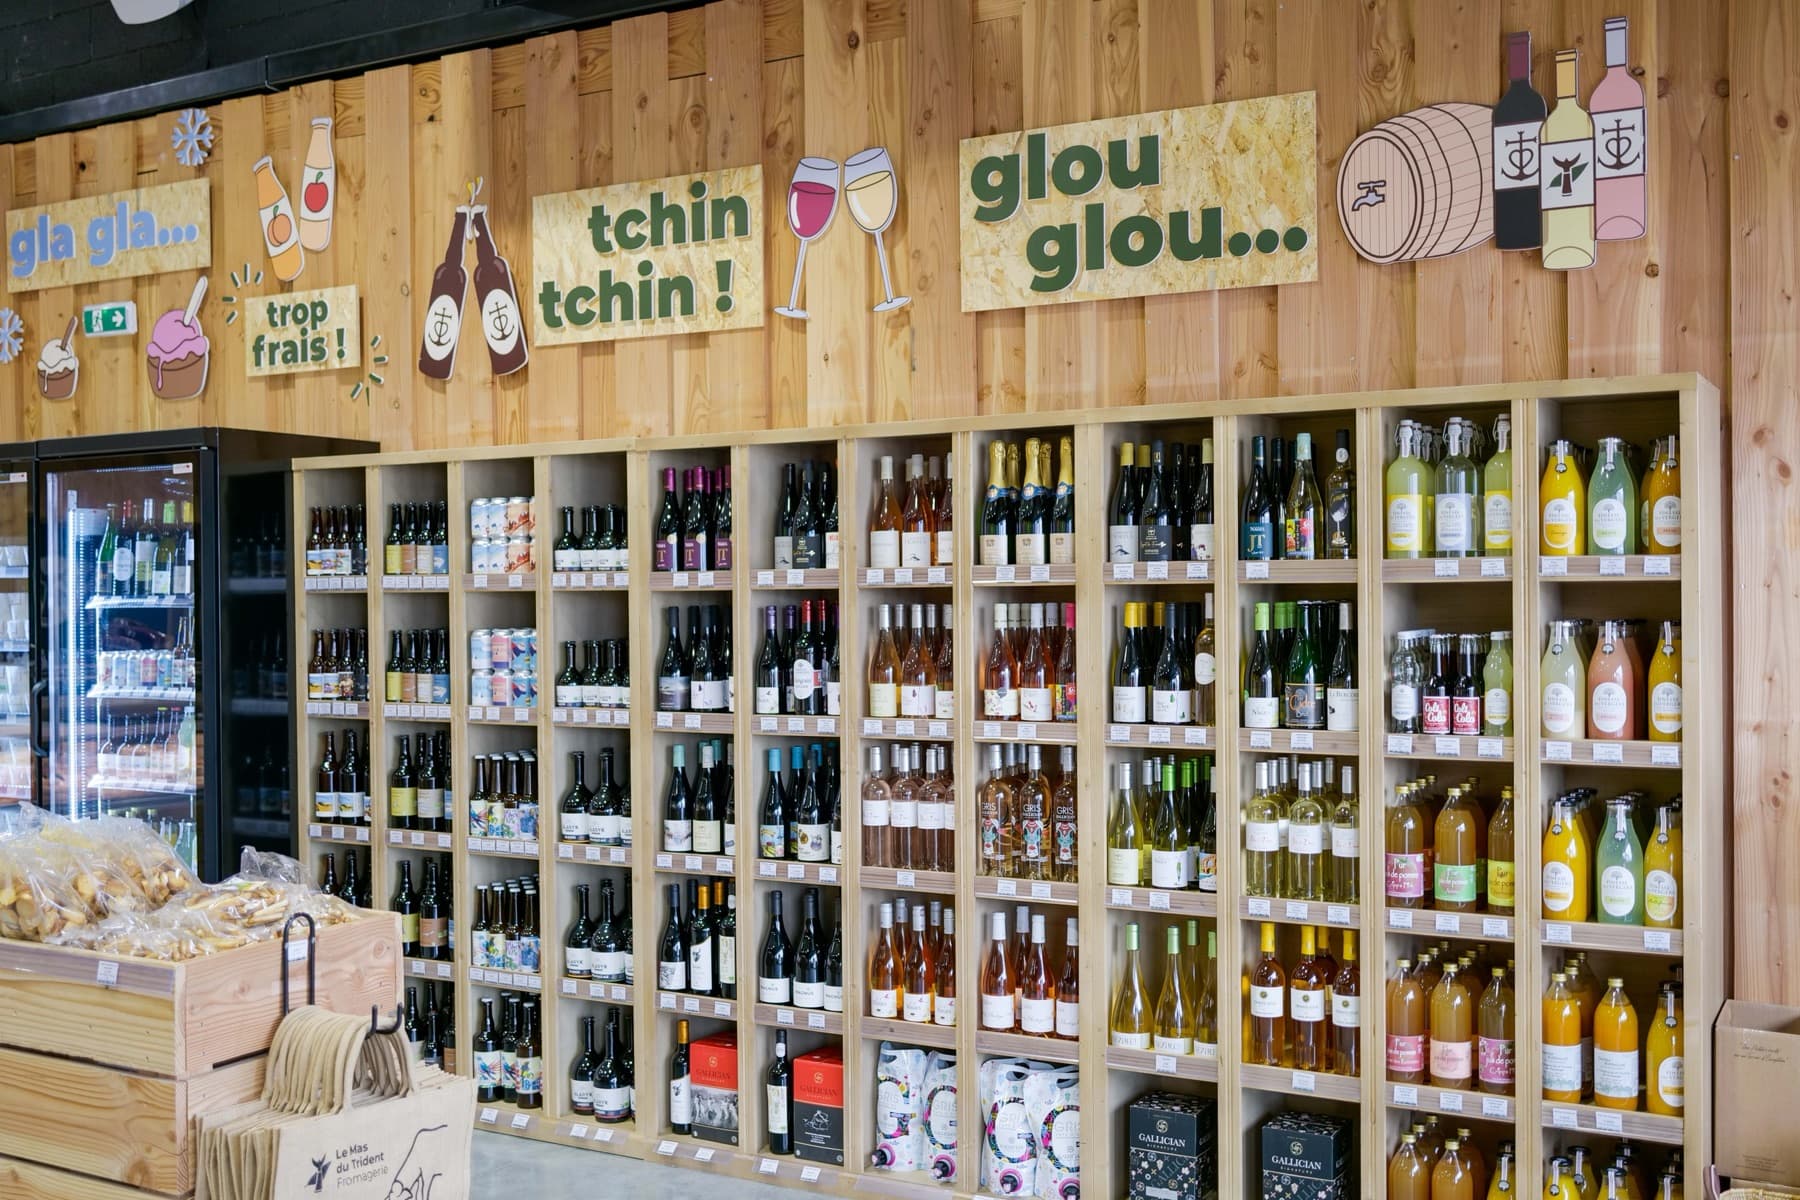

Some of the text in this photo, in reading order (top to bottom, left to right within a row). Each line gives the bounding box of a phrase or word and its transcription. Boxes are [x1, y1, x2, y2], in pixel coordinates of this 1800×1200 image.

[969, 132, 1162, 223] glou
[588, 180, 752, 254] tchin
[10, 202, 199, 278] gla gla...
[1026, 201, 1310, 293] glou...
[538, 259, 695, 329] tchin
[266, 299, 328, 338] trop
[252, 329, 327, 368] frais
[1023, 804, 1042, 813] GRIS
[1056, 806, 1074, 815] GRIS
[336, 1143, 369, 1160] Le Mas
[1138, 1133, 1186, 1147] GALLICIAN
[336, 1152, 385, 1173] du Trident
[337, 1166, 389, 1189] Fromagerie
[1271, 1155, 1322, 1170] GALLICIAN
